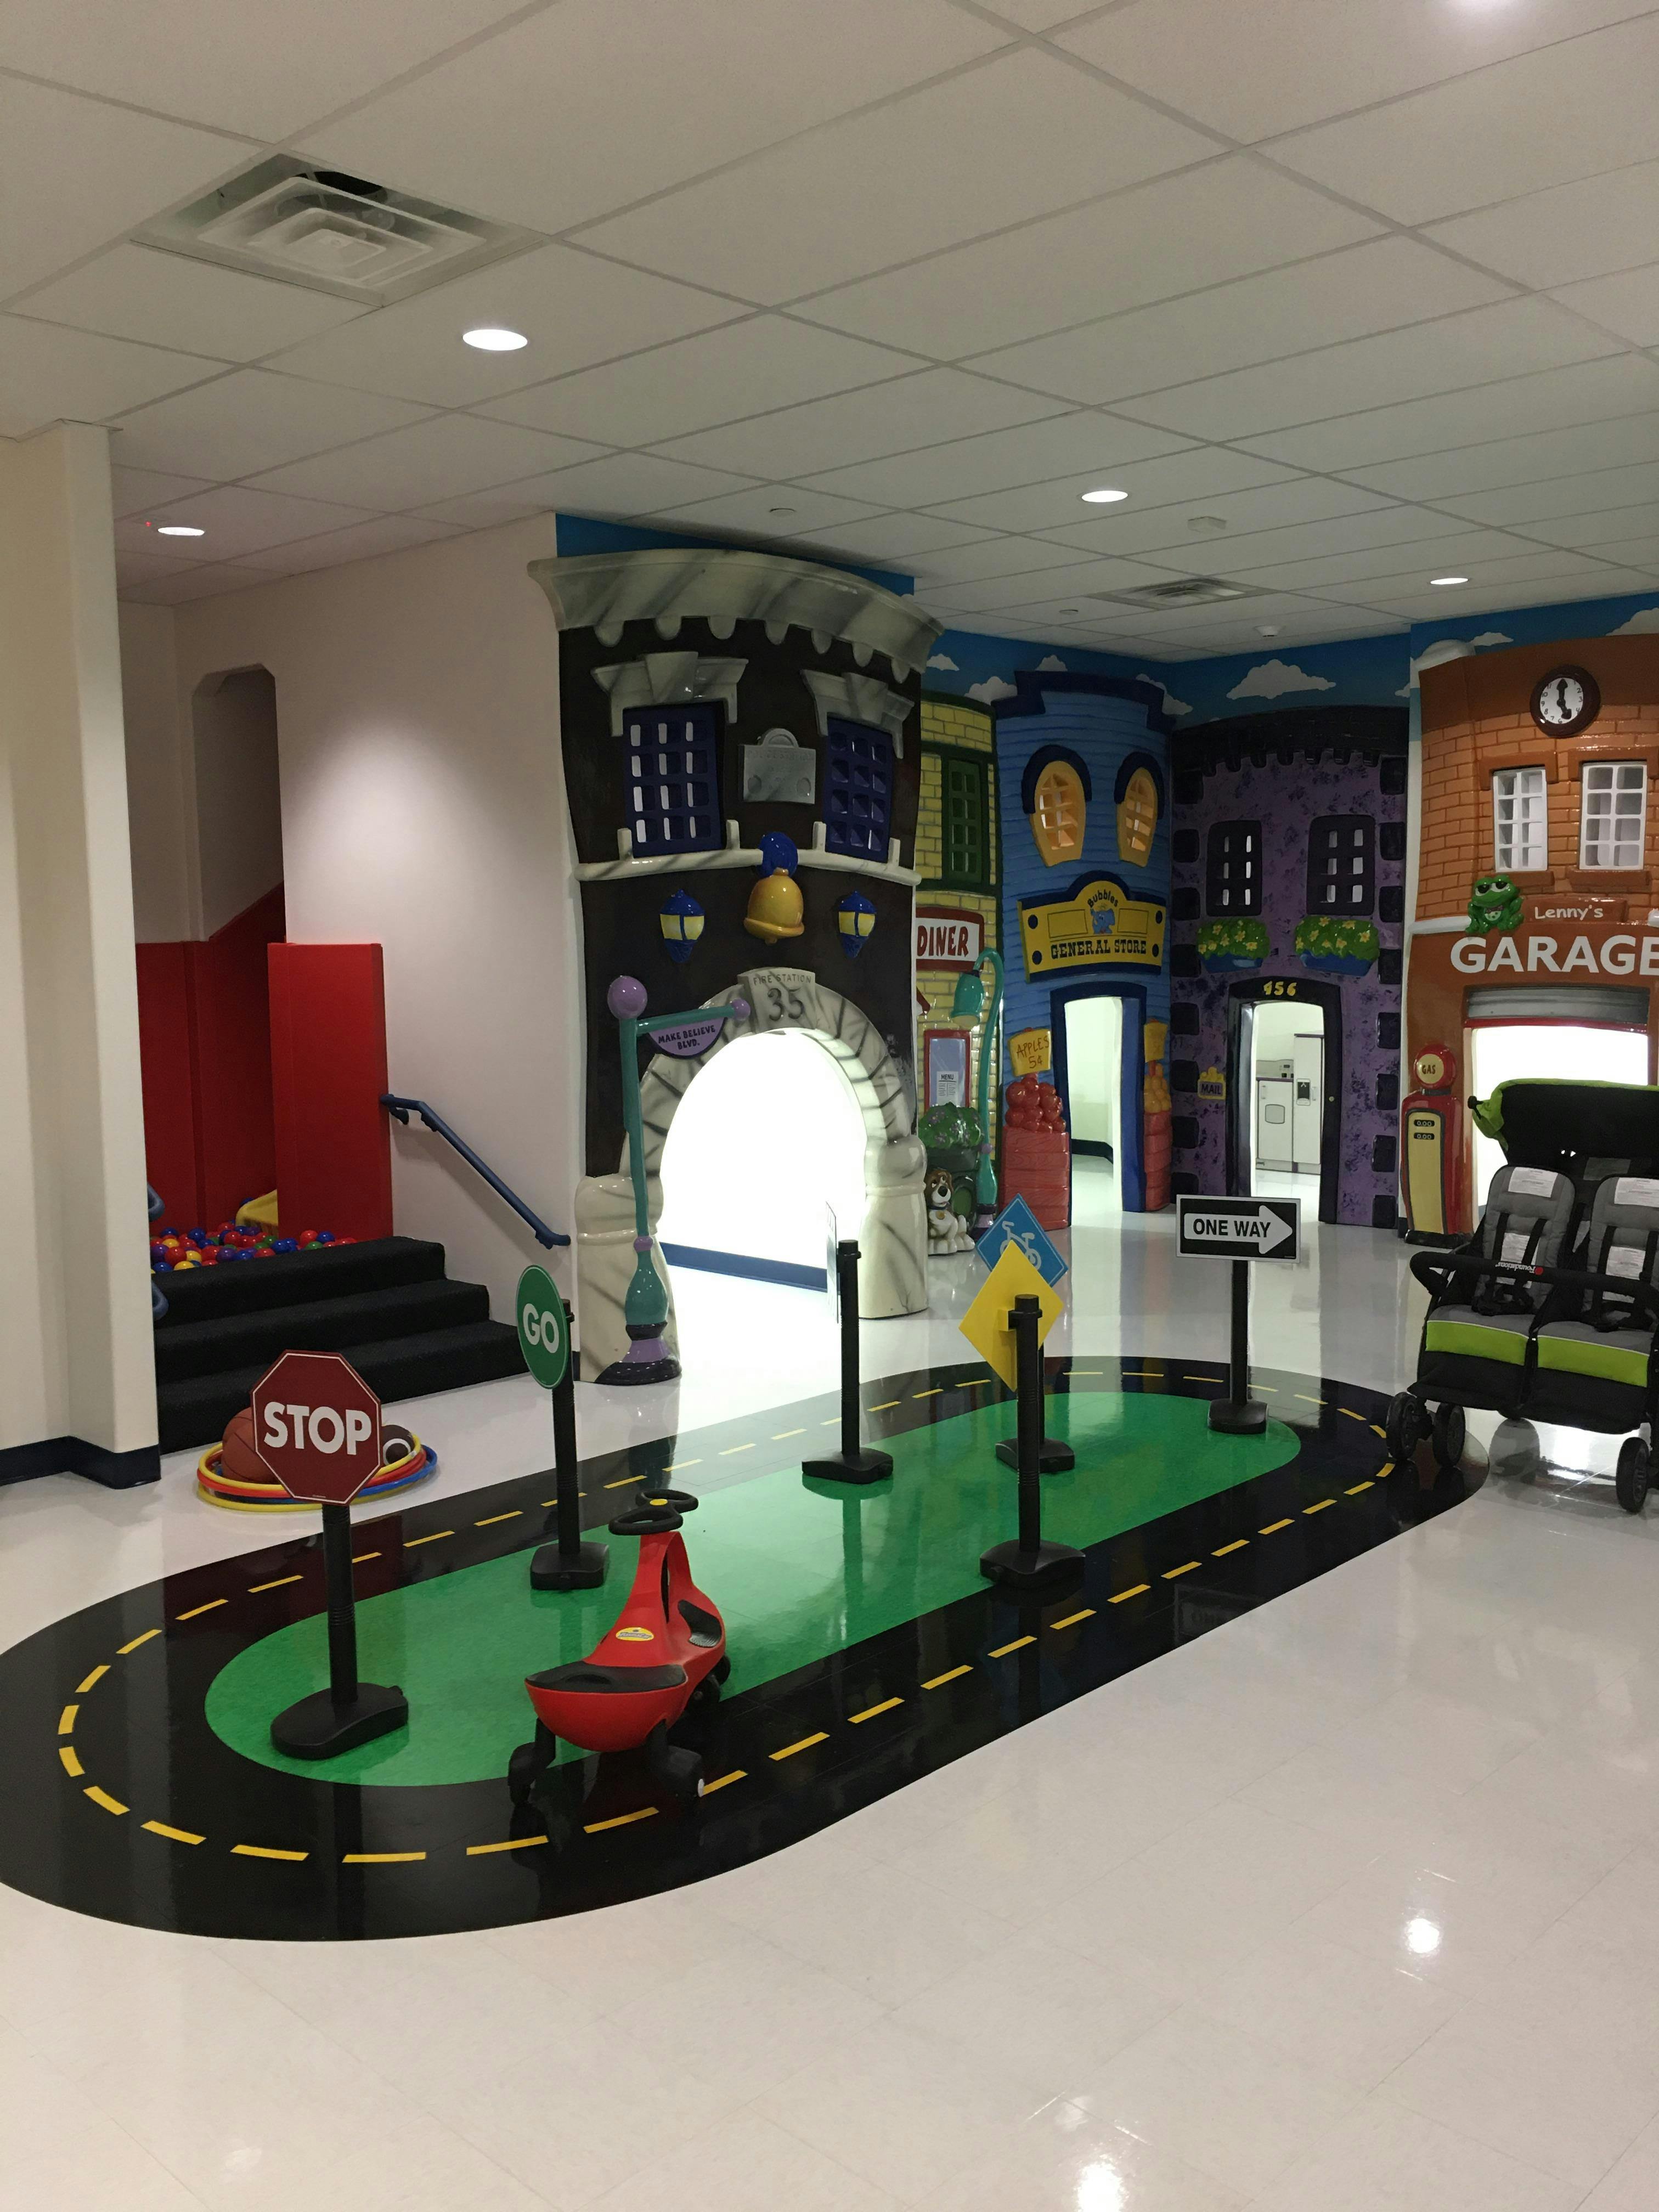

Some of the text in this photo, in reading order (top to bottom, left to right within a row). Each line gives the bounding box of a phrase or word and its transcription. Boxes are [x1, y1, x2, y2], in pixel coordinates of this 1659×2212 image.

[1087, 889, 1119, 908] Bubbles
[1534, 905, 1604, 921] Lenny's
[917, 925, 969, 957] DINER
[1051, 939, 1147, 960] GENERAL STORE
[1450, 934, 1659, 975] GARAGE
[753, 974, 811, 986] FIRE STATION
[1263, 981, 1297, 996] 456
[768, 988, 805, 1021] 35
[658, 1025, 716, 1043] MAKE BELIEVE
[677, 1039, 700, 1050] BLVD.
[1017, 1035, 1049, 1059] APPLES
[1421, 1064, 1436, 1075] GAS
[1201, 1084, 1221, 1095] MAIL
[1193, 1218, 1271, 1238] ONE WAY
[523, 1303, 560, 1353] GO
[264, 1402, 372, 1455] STOP
